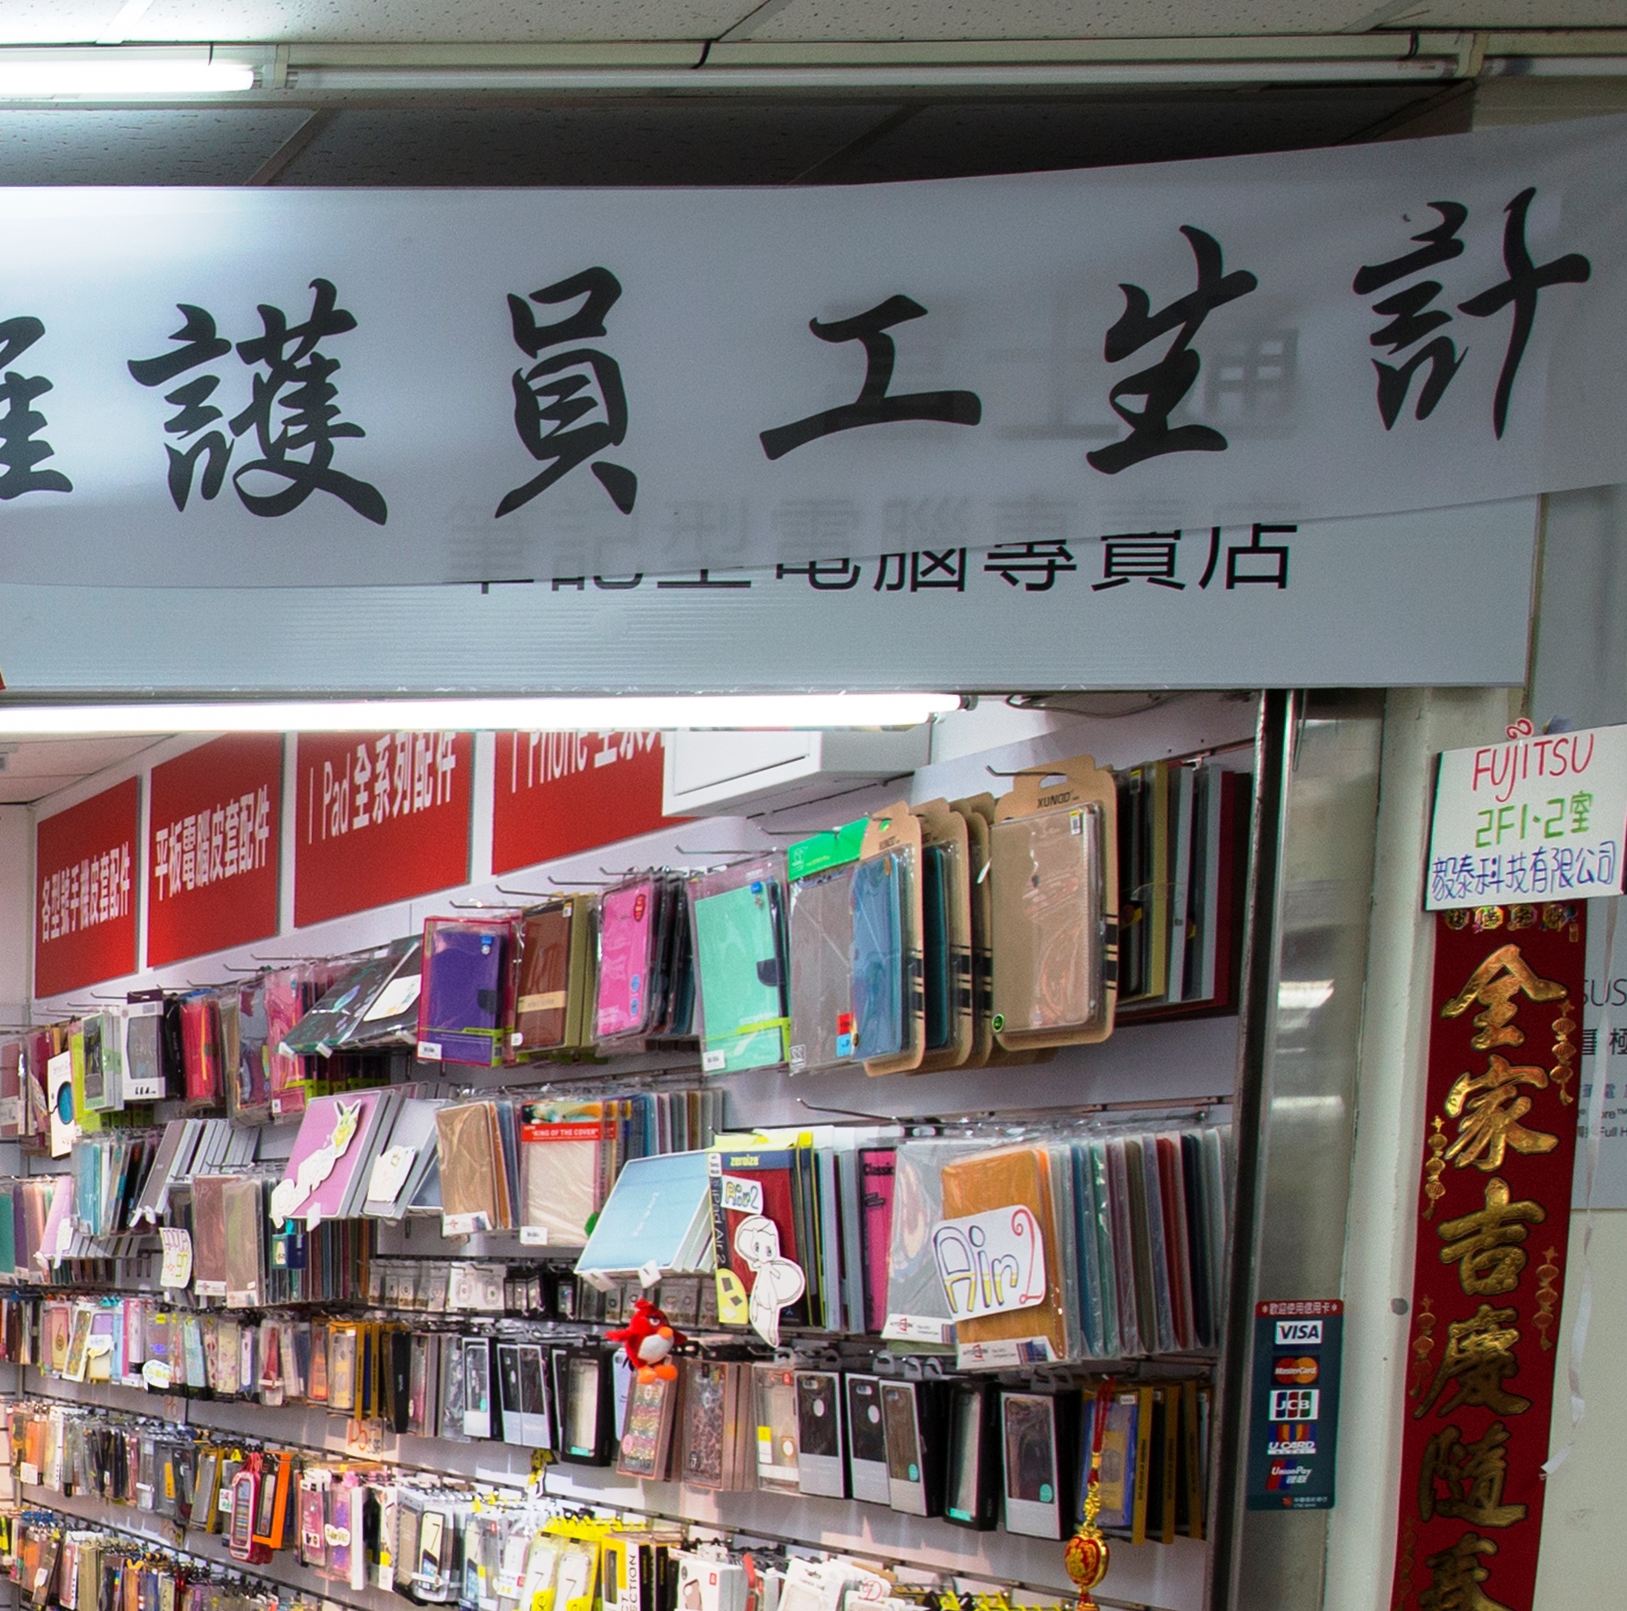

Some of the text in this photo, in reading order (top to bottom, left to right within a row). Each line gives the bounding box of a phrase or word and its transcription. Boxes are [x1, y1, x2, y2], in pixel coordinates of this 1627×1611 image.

[1472, 734, 1595, 802] FUJITSU
[321, 752, 352, 840] Pad
[932, 1208, 1044, 1314] Air 2
[1279, 1325, 1320, 1340] VISA
[1274, 1366, 1318, 1376] MasterCard
[1274, 1400, 1312, 1410] JCB
[1271, 1466, 1313, 1478] UnionPay
